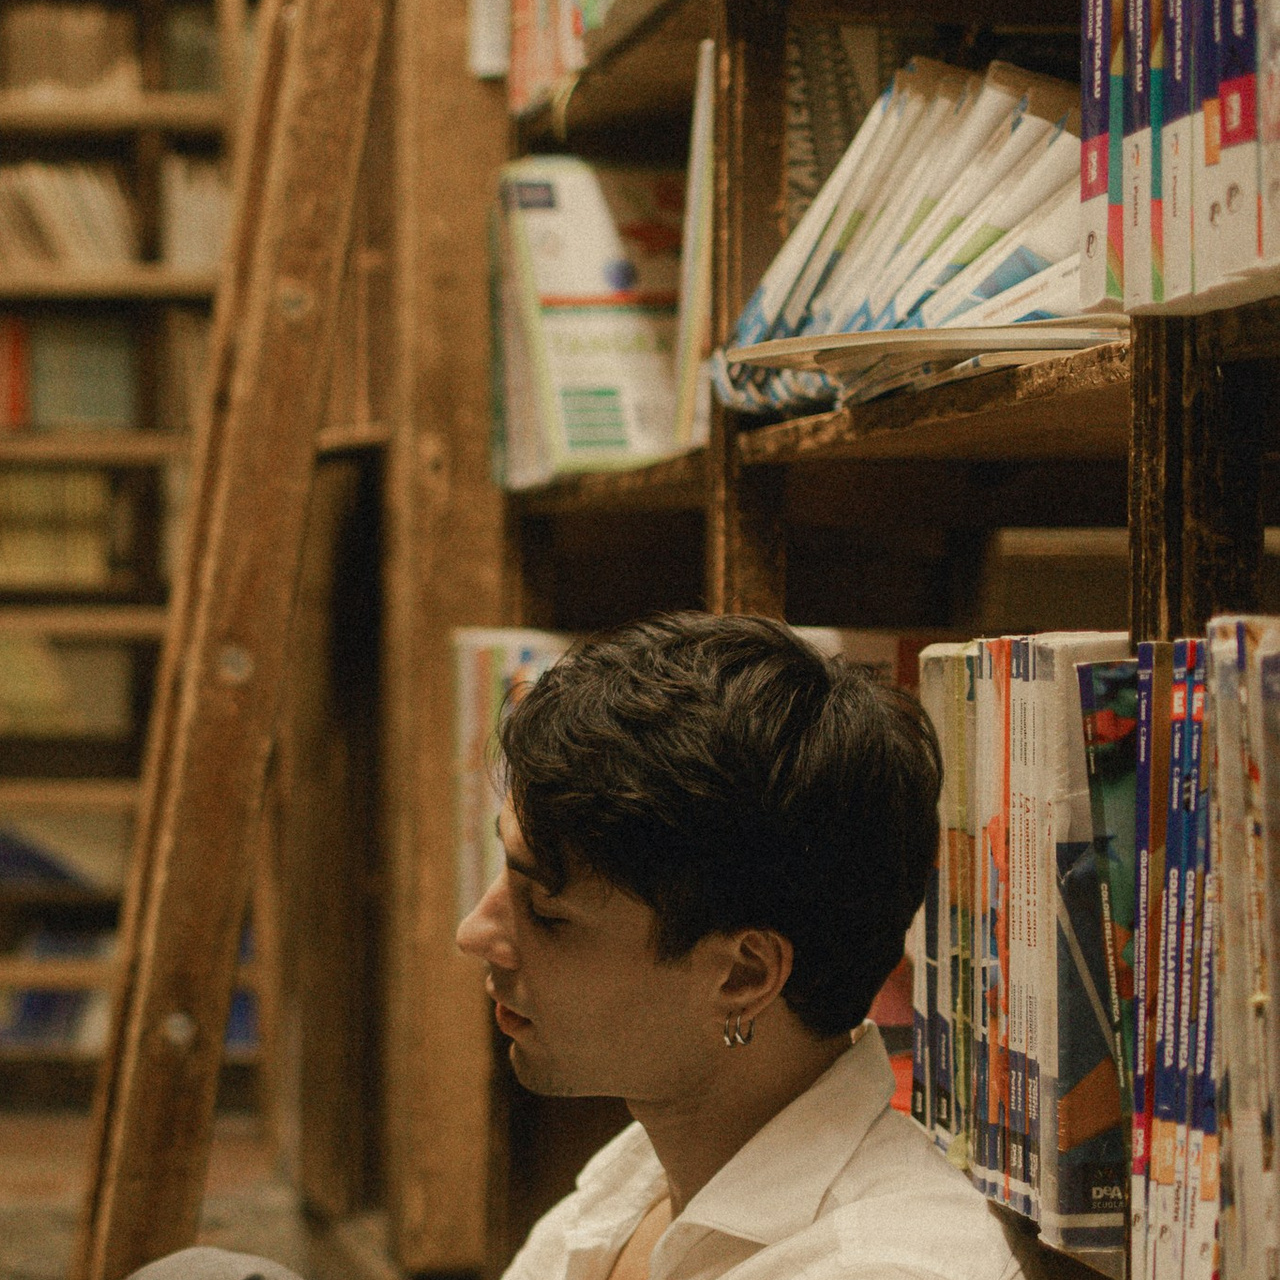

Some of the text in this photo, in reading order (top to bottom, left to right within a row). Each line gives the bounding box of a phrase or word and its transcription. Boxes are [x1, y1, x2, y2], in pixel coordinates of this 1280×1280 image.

[1093, 71, 1102, 99] BLU
[1135, 65, 1144, 92] BLU
[1175, 54, 1183, 81] BLU
[1173, 691, 1185, 714] E
[1192, 692, 1204, 715] F
[1140, 850, 1148, 885] COLORI
[1101, 883, 1111, 921] COLORI
[1140, 886, 1148, 916] DELLA
[1104, 922, 1115, 954] DELLA
[1139, 917, 1147, 979] MATEMATICA
[1202, 929, 1212, 976] DELLA
[1164, 869, 1179, 1068] COLORI DELLA MATEMATICA
[1178, 870, 1196, 1070] COLORI DELLA MATEMATICA
[1108, 955, 1121, 1023] MATEMATICA
[1138, 981, 1146, 1000] BLU
[1197, 978, 1209, 1075] MATEMATICA
[1092, 1186, 1123, 1200] DeA
[1174, 1180, 1183, 1223] Petrini
[1190, 1186, 1198, 1229] Petrini
